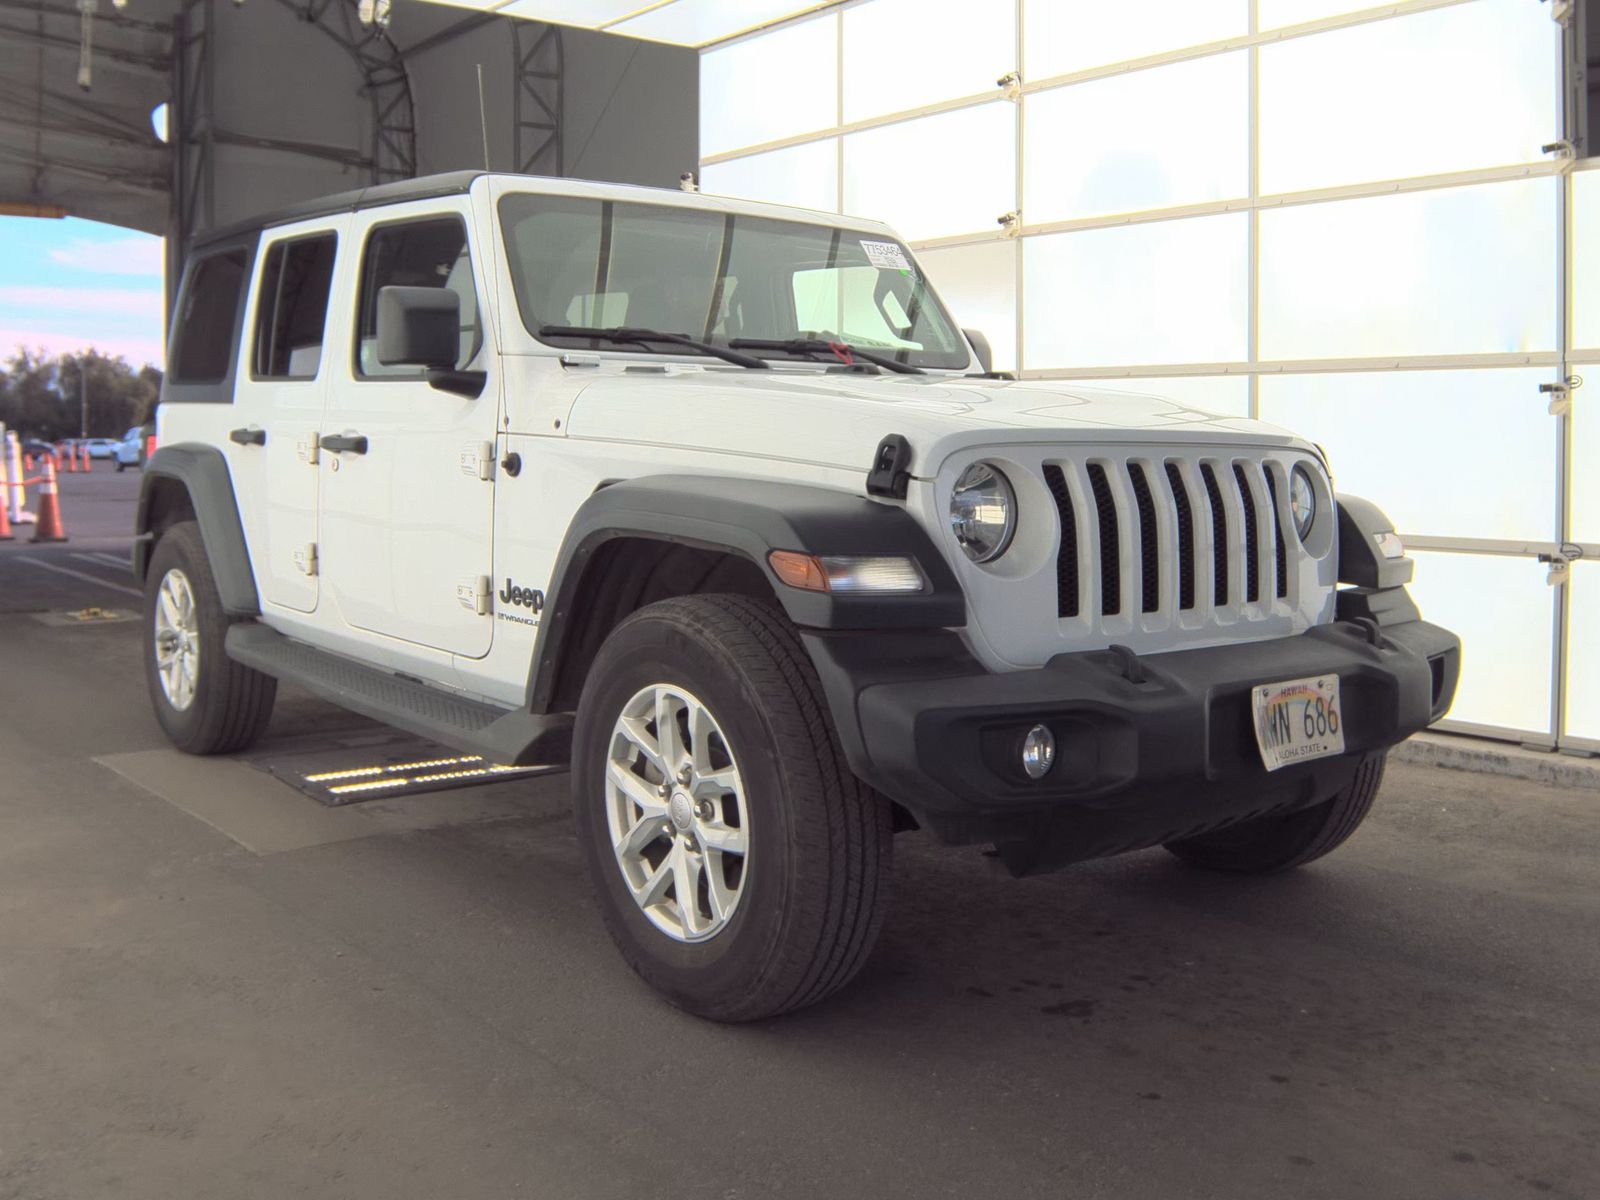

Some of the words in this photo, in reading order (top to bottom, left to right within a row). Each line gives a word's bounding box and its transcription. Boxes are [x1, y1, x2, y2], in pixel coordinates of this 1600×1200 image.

[499, 577, 544, 615] Jeep
[1303, 695, 1338, 739] 686
[1300, 743, 1321, 755] STATE
